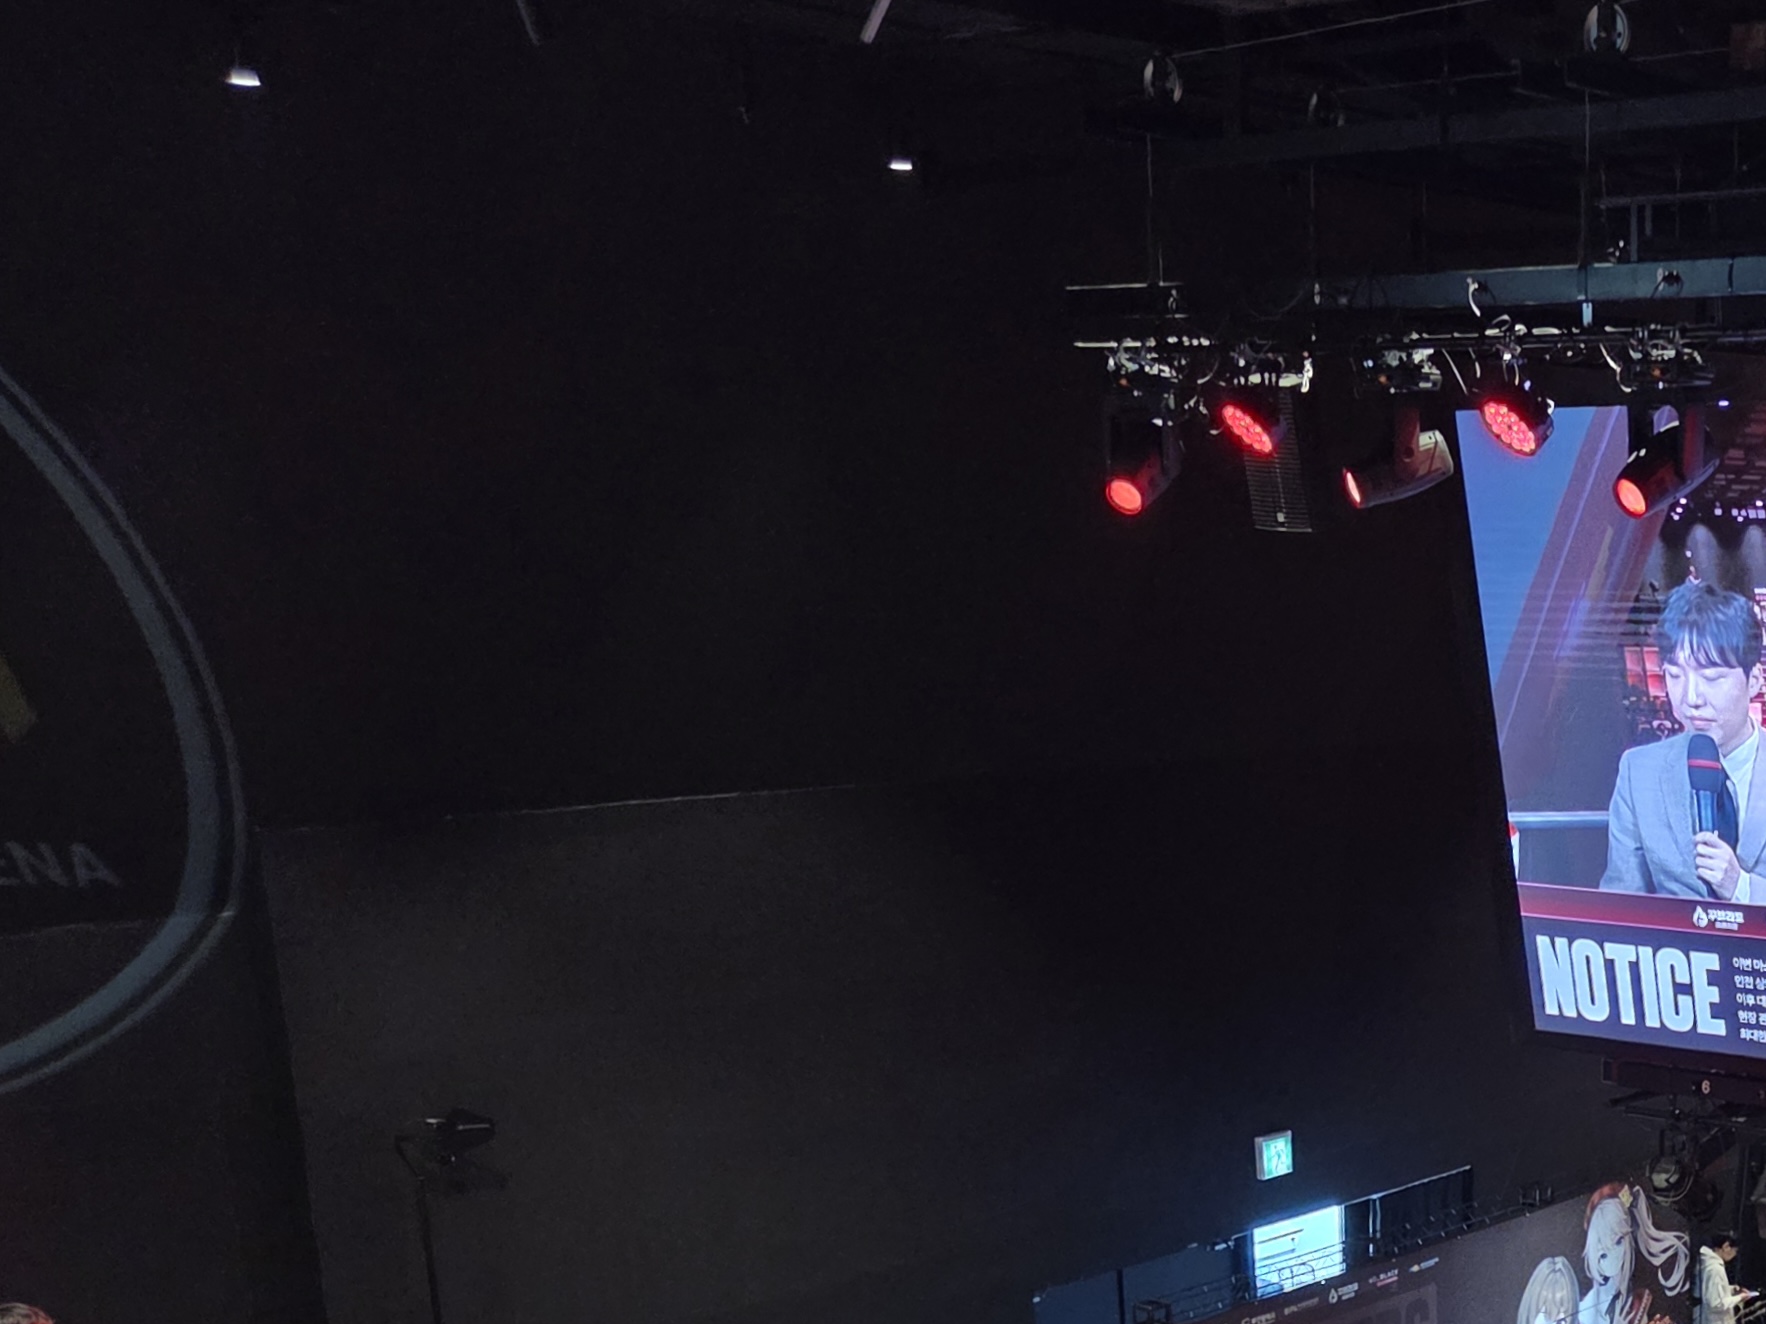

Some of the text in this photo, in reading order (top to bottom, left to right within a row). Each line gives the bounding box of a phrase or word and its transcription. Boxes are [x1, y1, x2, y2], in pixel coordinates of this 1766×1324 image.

[1732, 956, 1751, 971] 이번
[1536, 934, 1726, 1036] NOTICE
[1734, 974, 1752, 989] 안전
[1736, 992, 1754, 1006] 이후
[1737, 1010, 1756, 1024] 현장
[1701, 1080, 1710, 1094] 6
